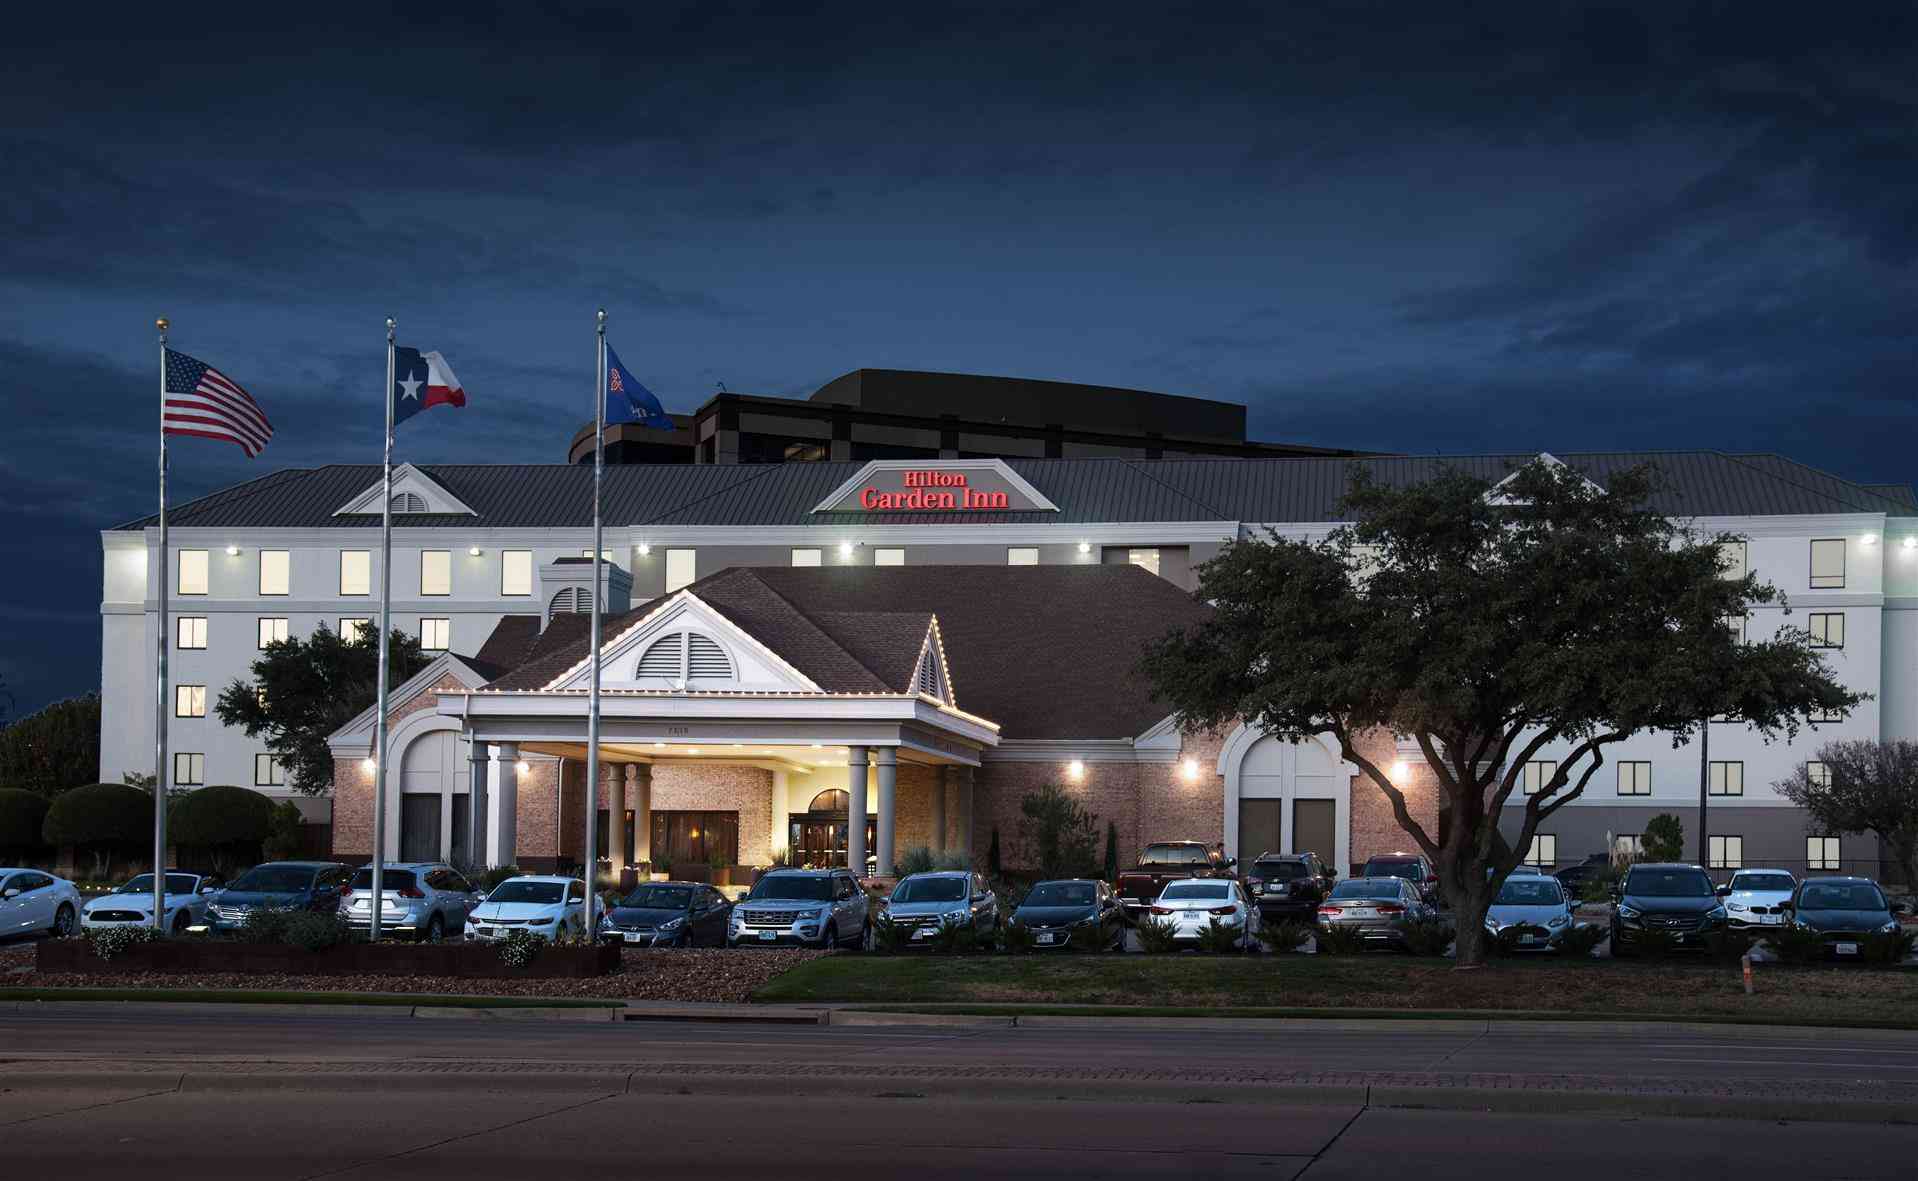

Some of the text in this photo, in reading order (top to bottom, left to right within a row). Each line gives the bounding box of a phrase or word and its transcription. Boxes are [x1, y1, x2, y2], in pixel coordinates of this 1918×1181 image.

[904, 471, 966, 487] Hilton
[860, 487, 1008, 509] Garden Inn
